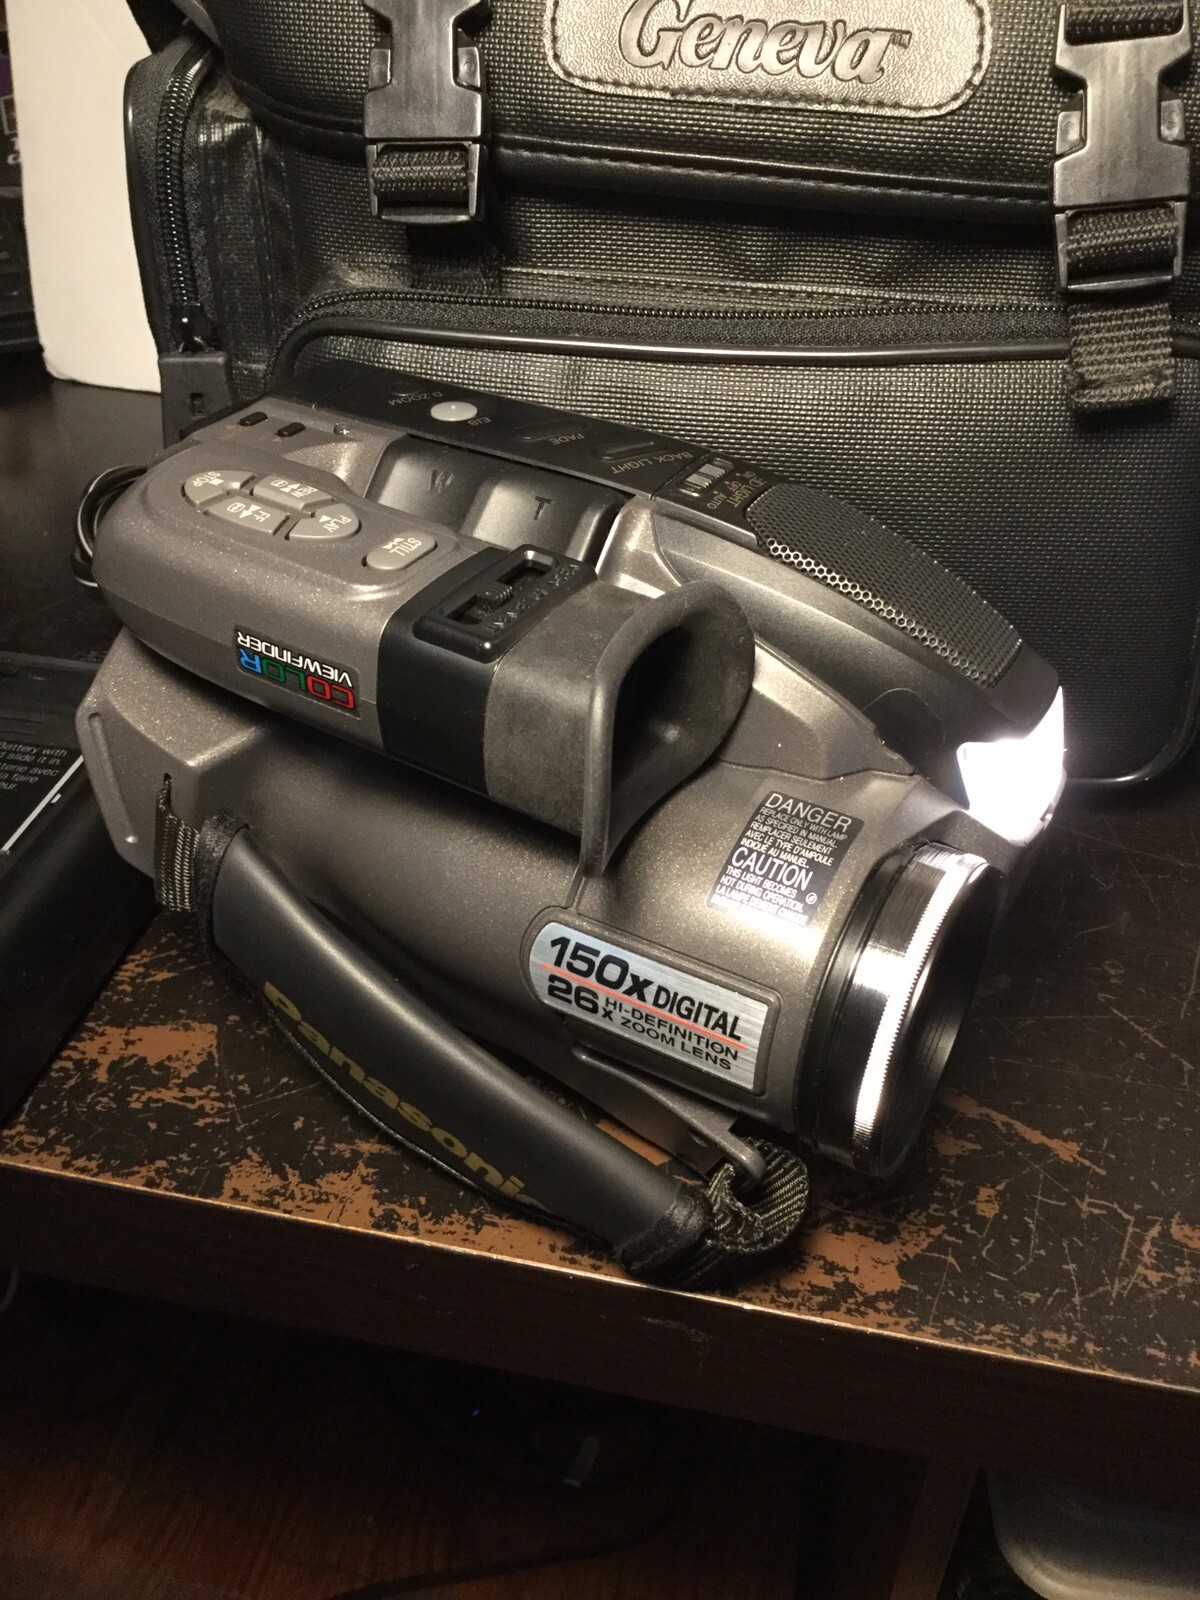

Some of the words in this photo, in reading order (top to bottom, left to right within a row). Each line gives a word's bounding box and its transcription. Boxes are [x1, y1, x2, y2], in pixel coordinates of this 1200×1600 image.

[618, 0, 911, 84] Geneva
[387, 393, 431, 406] ZOOM
[547, 432, 586, 446] FADE
[611, 458, 654, 475] LIGHT
[653, 450, 694, 464] BACK
[193, 471, 222, 487] STOP
[534, 495, 552, 521] T
[707, 492, 727, 510] AUTO
[253, 510, 271, 523] FF
[322, 514, 352, 533] PLAY
[389, 537, 422, 557] STILL
[236, 630, 353, 688] VIEWFINDER
[239, 647, 355, 710] COLOR
[754, 814, 766, 823] AS
[765, 817, 799, 834] SPECIFIED
[799, 828, 807, 837] IN
[760, 807, 790, 823] REPLACE
[790, 817, 810, 828] ONLY
[809, 823, 828, 835] WITH
[826, 828, 848, 841] LAMP
[765, 793, 852, 832] DANGER
[745, 829, 764, 841] AVEC
[775, 839, 793, 852] TYPE
[793, 845, 834, 866] D'AMPOULE
[750, 821, 791, 840] REMPLACER
[791, 835, 833, 855] SEULEMENT
[768, 847, 779, 857] AU
[725, 865, 742, 878] THIS
[741, 871, 764, 885] LIGHT
[762, 879, 797, 898] BECOMES
[731, 846, 813, 891] CAUTION
[720, 874, 737, 887] HOT
[736, 880, 763, 898] DURING
[550, 936, 655, 1003] 150x
[652, 984, 742, 1042] DIGITAL
[604, 997, 738, 1060] HI-DEFINITION
[620, 1016, 676, 1047] ZOOM
[680, 1041, 732, 1071] LENS
[263, 980, 548, 1212] Panasoni
